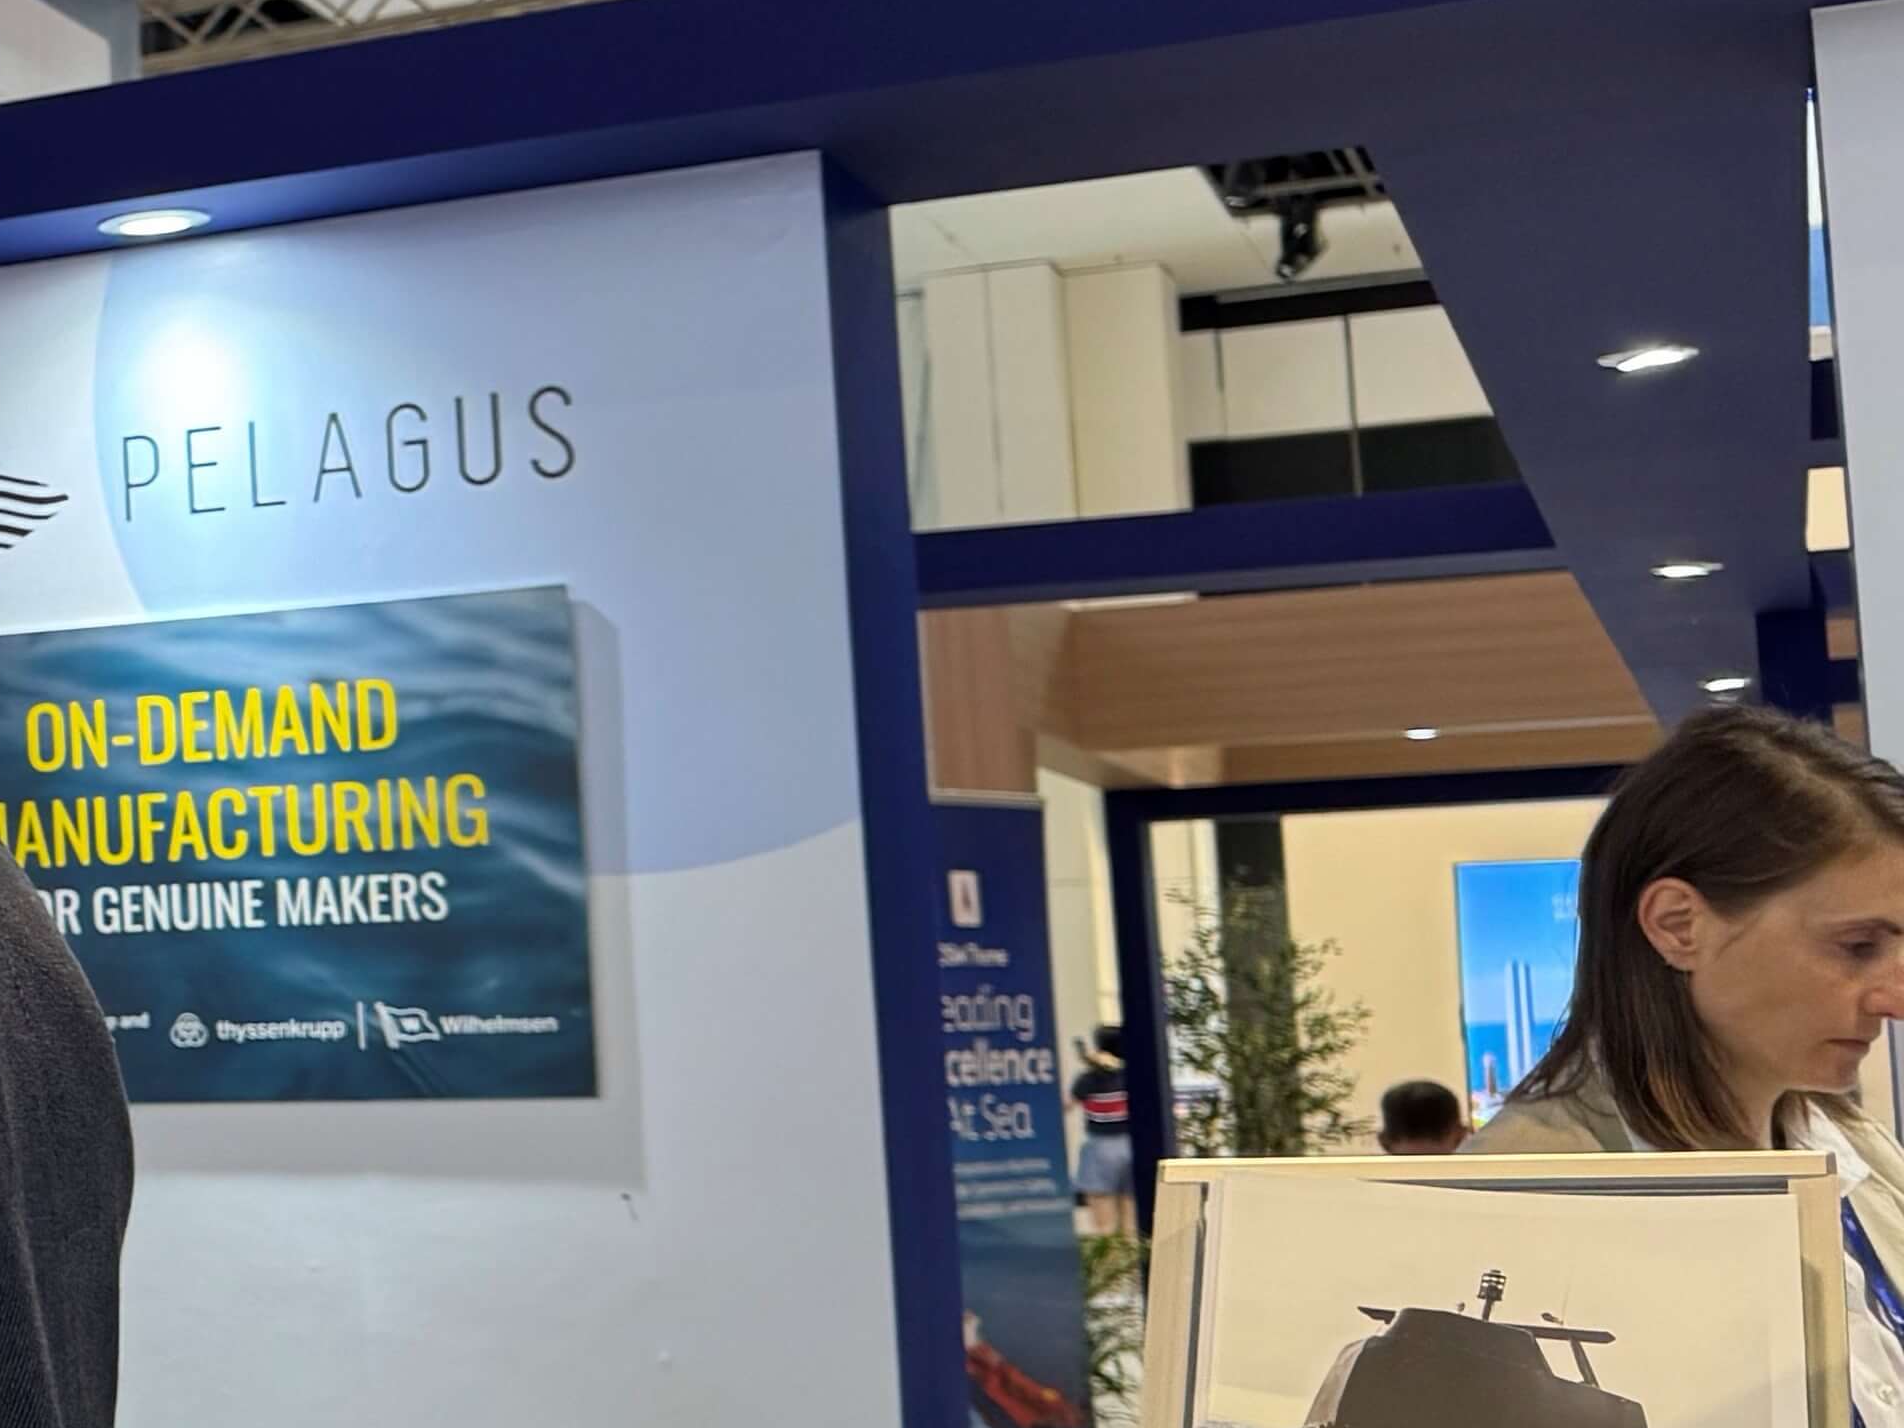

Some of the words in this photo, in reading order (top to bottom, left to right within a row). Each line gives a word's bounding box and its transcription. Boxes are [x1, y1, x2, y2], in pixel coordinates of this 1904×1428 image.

[121, 384, 577, 523] PELAGUS
[24, 677, 398, 774] ON-DEMAND
[92, 877, 265, 935] GENUINE
[276, 871, 449, 928] MAKERS
[215, 1017, 348, 1043] thyssenkrupp
[439, 1015, 560, 1035] Wilhelmsen
[941, 983, 1037, 1043] eading
[945, 1038, 1055, 1088] cellence
